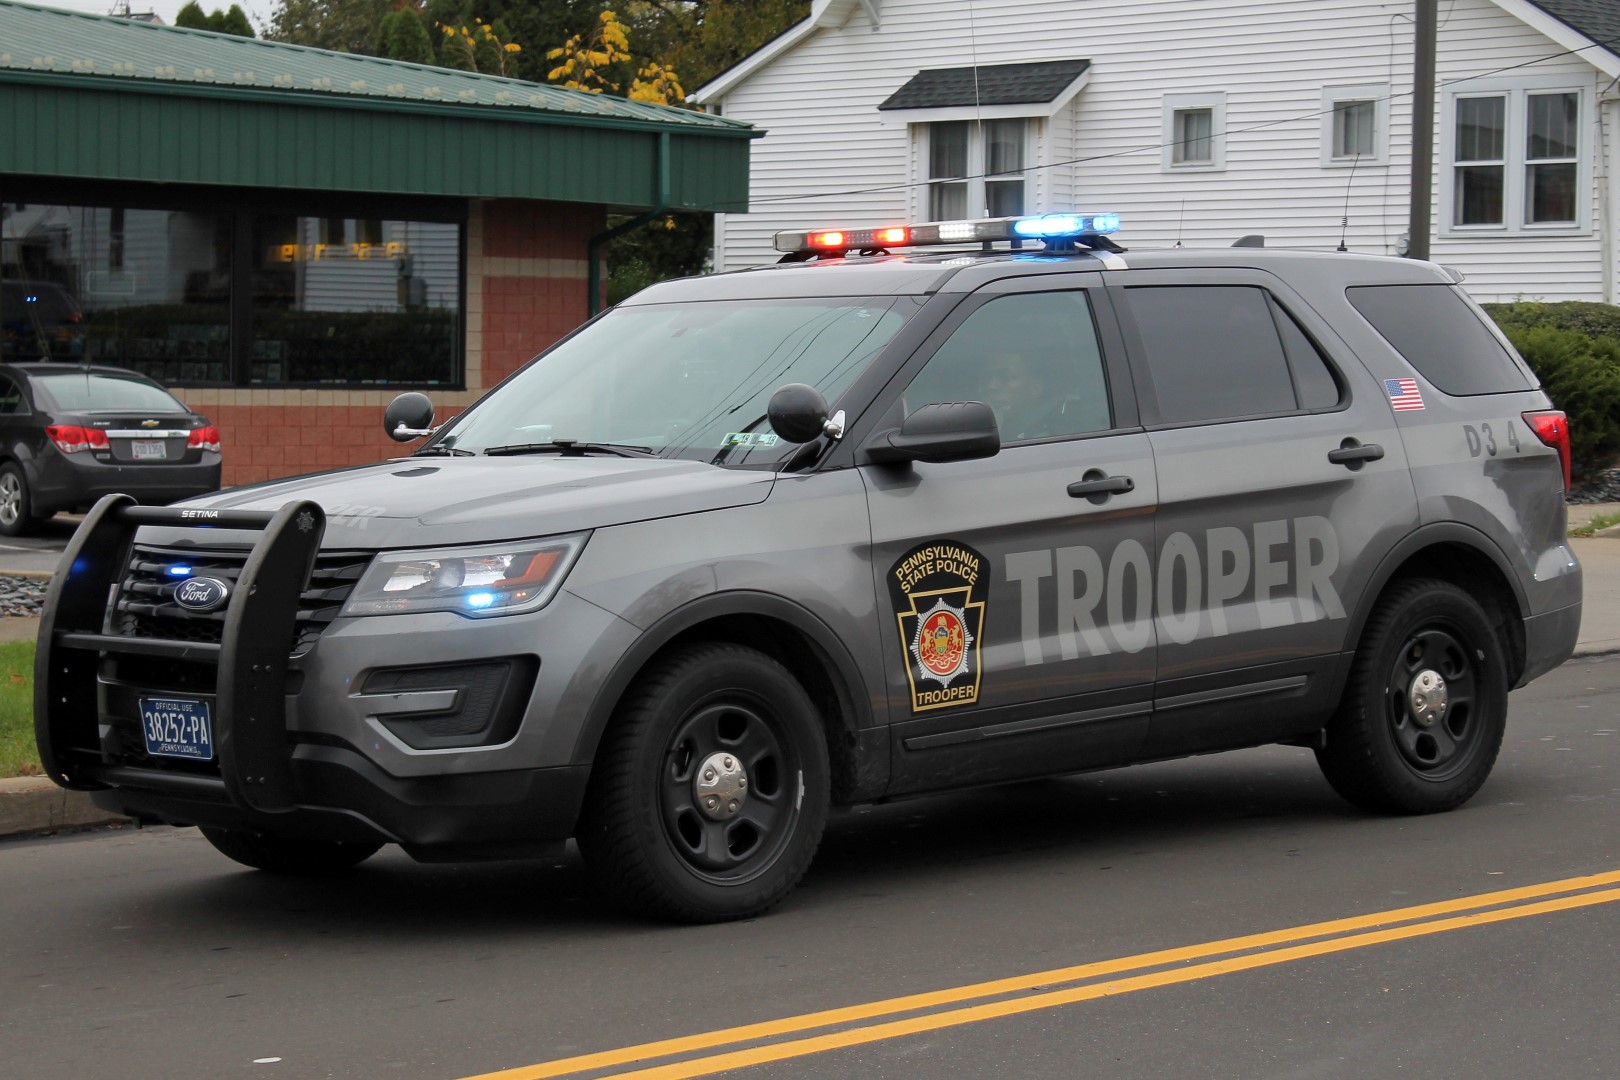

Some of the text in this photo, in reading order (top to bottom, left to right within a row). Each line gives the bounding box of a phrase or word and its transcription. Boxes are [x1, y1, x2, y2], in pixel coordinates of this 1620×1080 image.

[181, 510, 219, 518] SETINA
[895, 546, 979, 581] PENNSYLVANIA
[901, 560, 978, 593] STATE POLICE
[181, 582, 211, 601] Ford
[1005, 515, 1347, 666] TROOPER
[155, 702, 193, 712] OFFICIAL USE
[917, 685, 974, 705] TROOPER
[145, 712, 209, 744] 38252-PA
